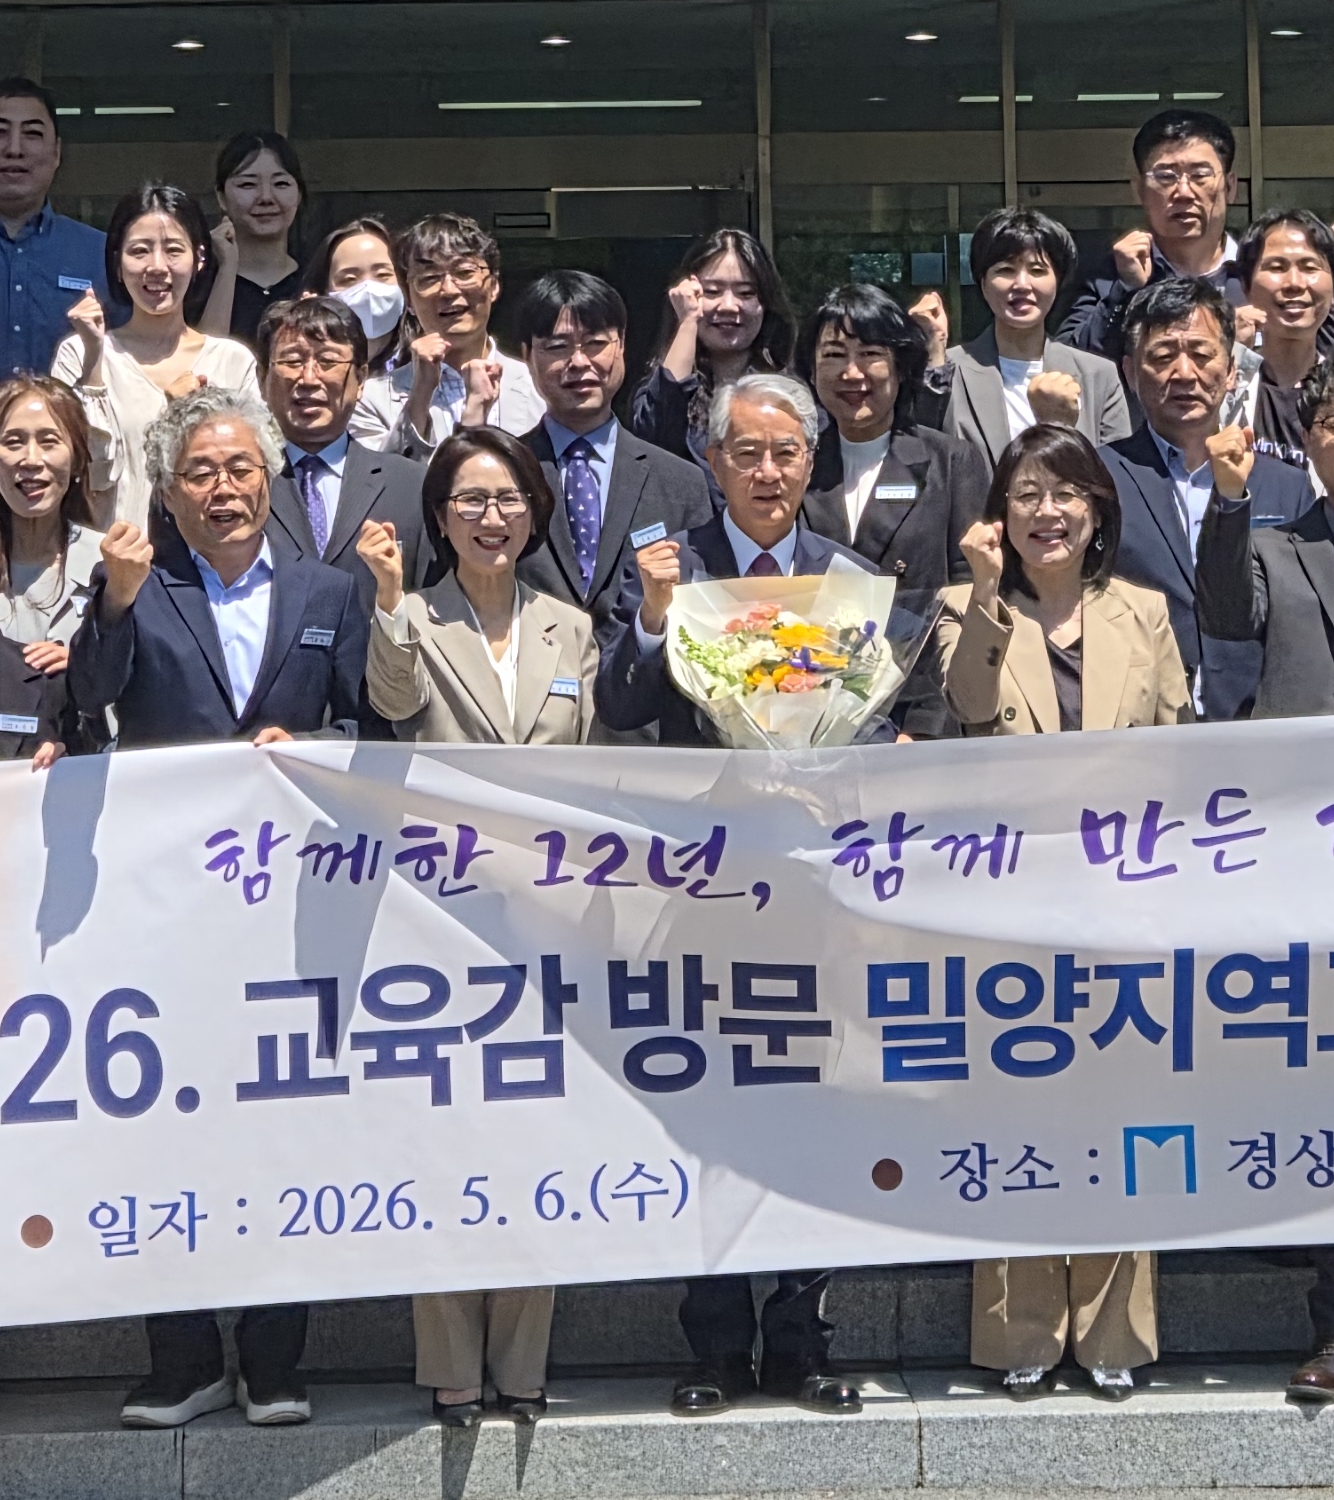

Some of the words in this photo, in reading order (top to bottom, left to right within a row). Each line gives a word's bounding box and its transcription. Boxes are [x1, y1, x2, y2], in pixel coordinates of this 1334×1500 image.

[204, 820, 494, 905] 함께한
[533, 824, 772, 912] 12년,
[831, 812, 1025, 901] 함께
[1079, 787, 1267, 882] 만든
[235, 953, 579, 1107] 교육감
[606, 953, 833, 1094] 방문
[88, 1190, 208, 1259] 일자
[278, 1179, 434, 1238] 2026.
[459, 1175, 508, 1227] 5.
[533, 1158, 690, 1224] 6.(수)
[938, 1141, 1061, 1203] 장소
